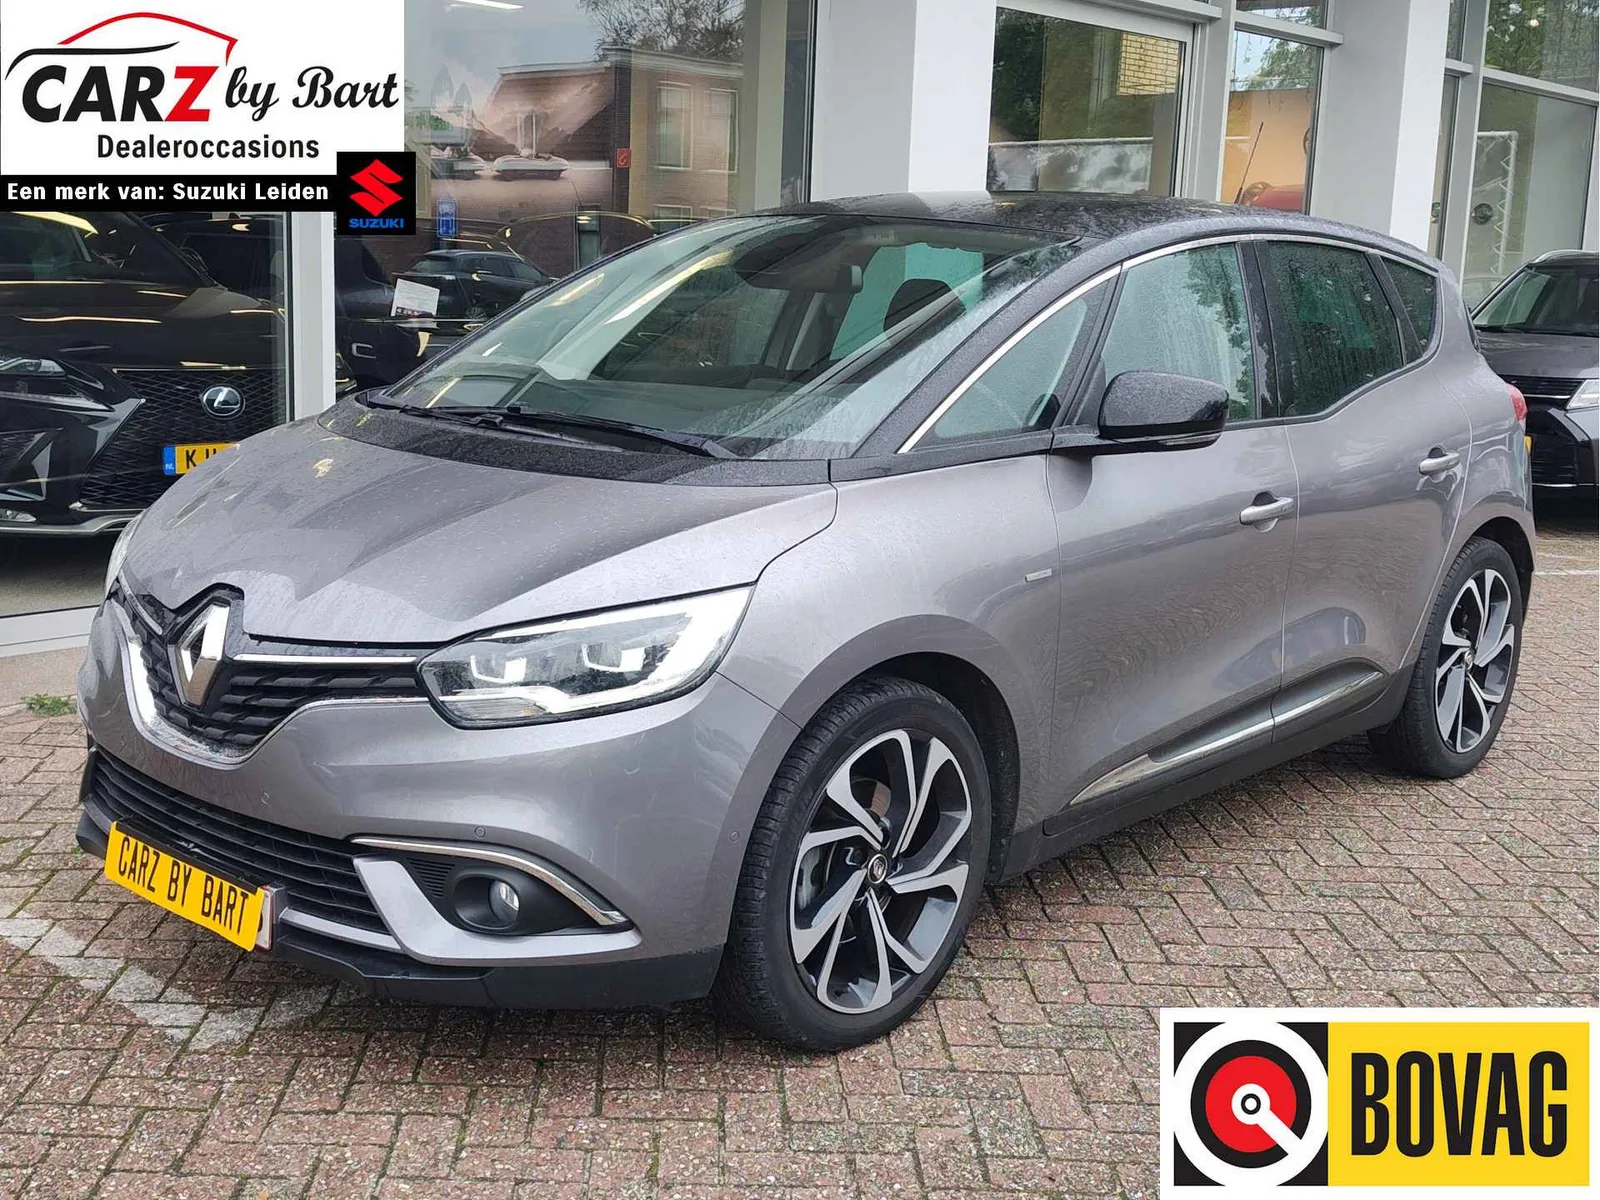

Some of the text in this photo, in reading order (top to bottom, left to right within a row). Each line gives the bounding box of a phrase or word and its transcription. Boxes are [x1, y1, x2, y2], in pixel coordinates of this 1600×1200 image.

[185, 448, 217, 470] K
[117, 836, 250, 936] CARZ BY BART
